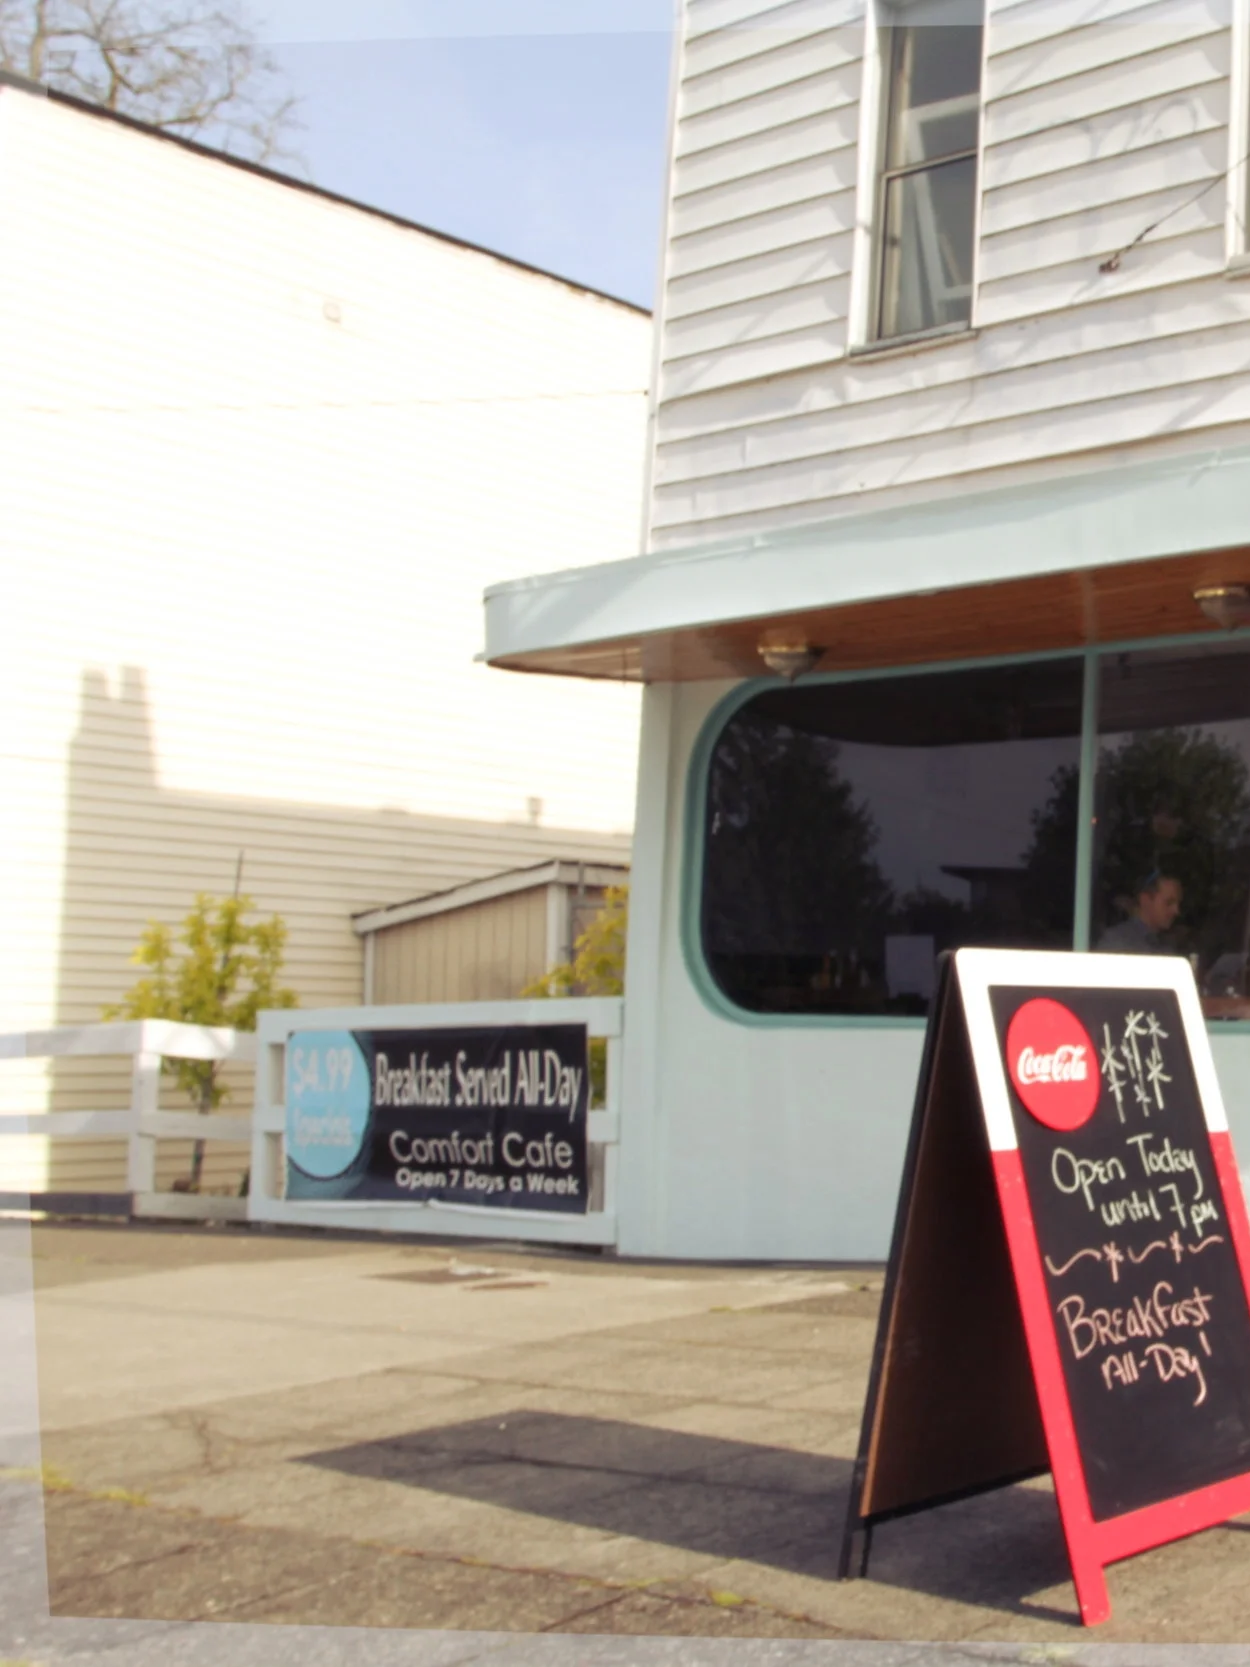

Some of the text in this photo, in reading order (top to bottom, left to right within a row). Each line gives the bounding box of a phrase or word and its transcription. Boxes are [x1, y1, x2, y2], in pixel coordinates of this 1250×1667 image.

[293, 1047, 354, 1098] $4.99
[375, 1049, 582, 1123] Breakfast Served All-Day
[1017, 1045, 1088, 1085] Coca-Cola
[389, 1130, 573, 1169] Comfort Cafe
[1052, 1133, 1203, 1211] Open Today
[395, 1167, 579, 1195] Open 7 Days a Week
[1100, 1189, 1162, 1226] until
[1159, 1183, 1187, 1229] 7
